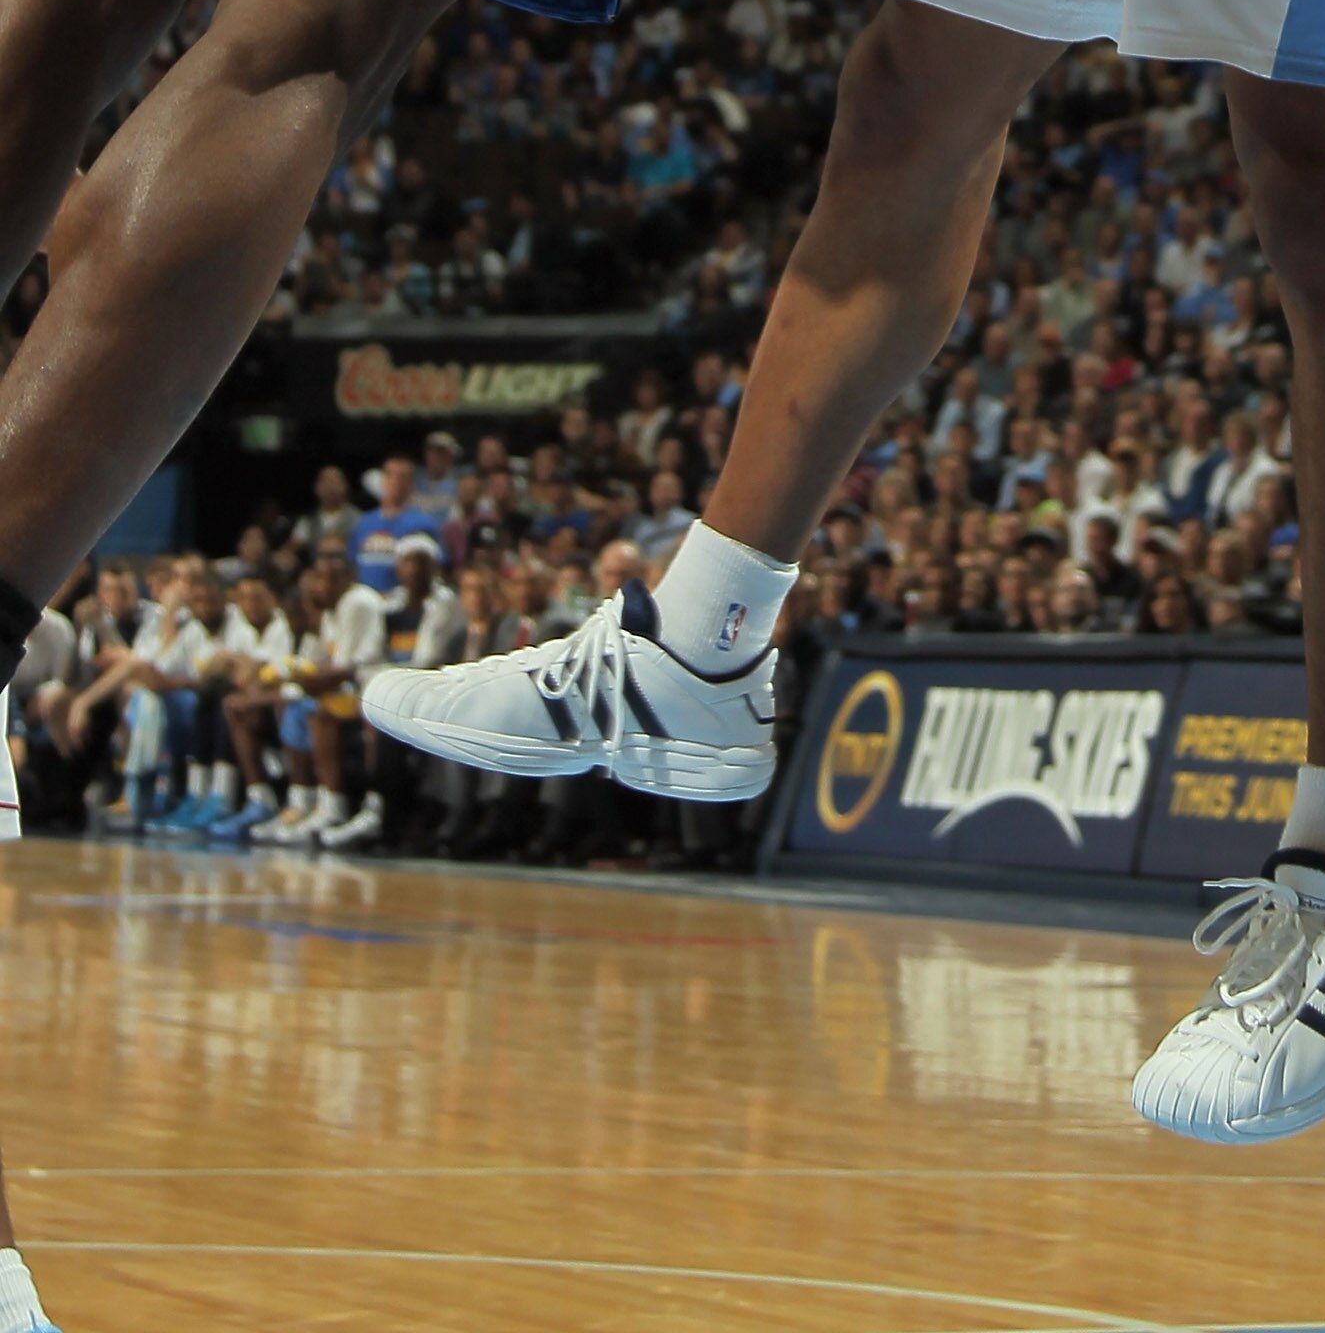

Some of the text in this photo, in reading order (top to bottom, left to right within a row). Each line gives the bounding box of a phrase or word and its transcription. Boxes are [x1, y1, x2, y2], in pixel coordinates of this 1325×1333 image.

[900, 685, 1167, 820] FALLING SKIES
[1174, 713, 1308, 765] PREMIER
[1169, 770, 1297, 823] THIS JUN
